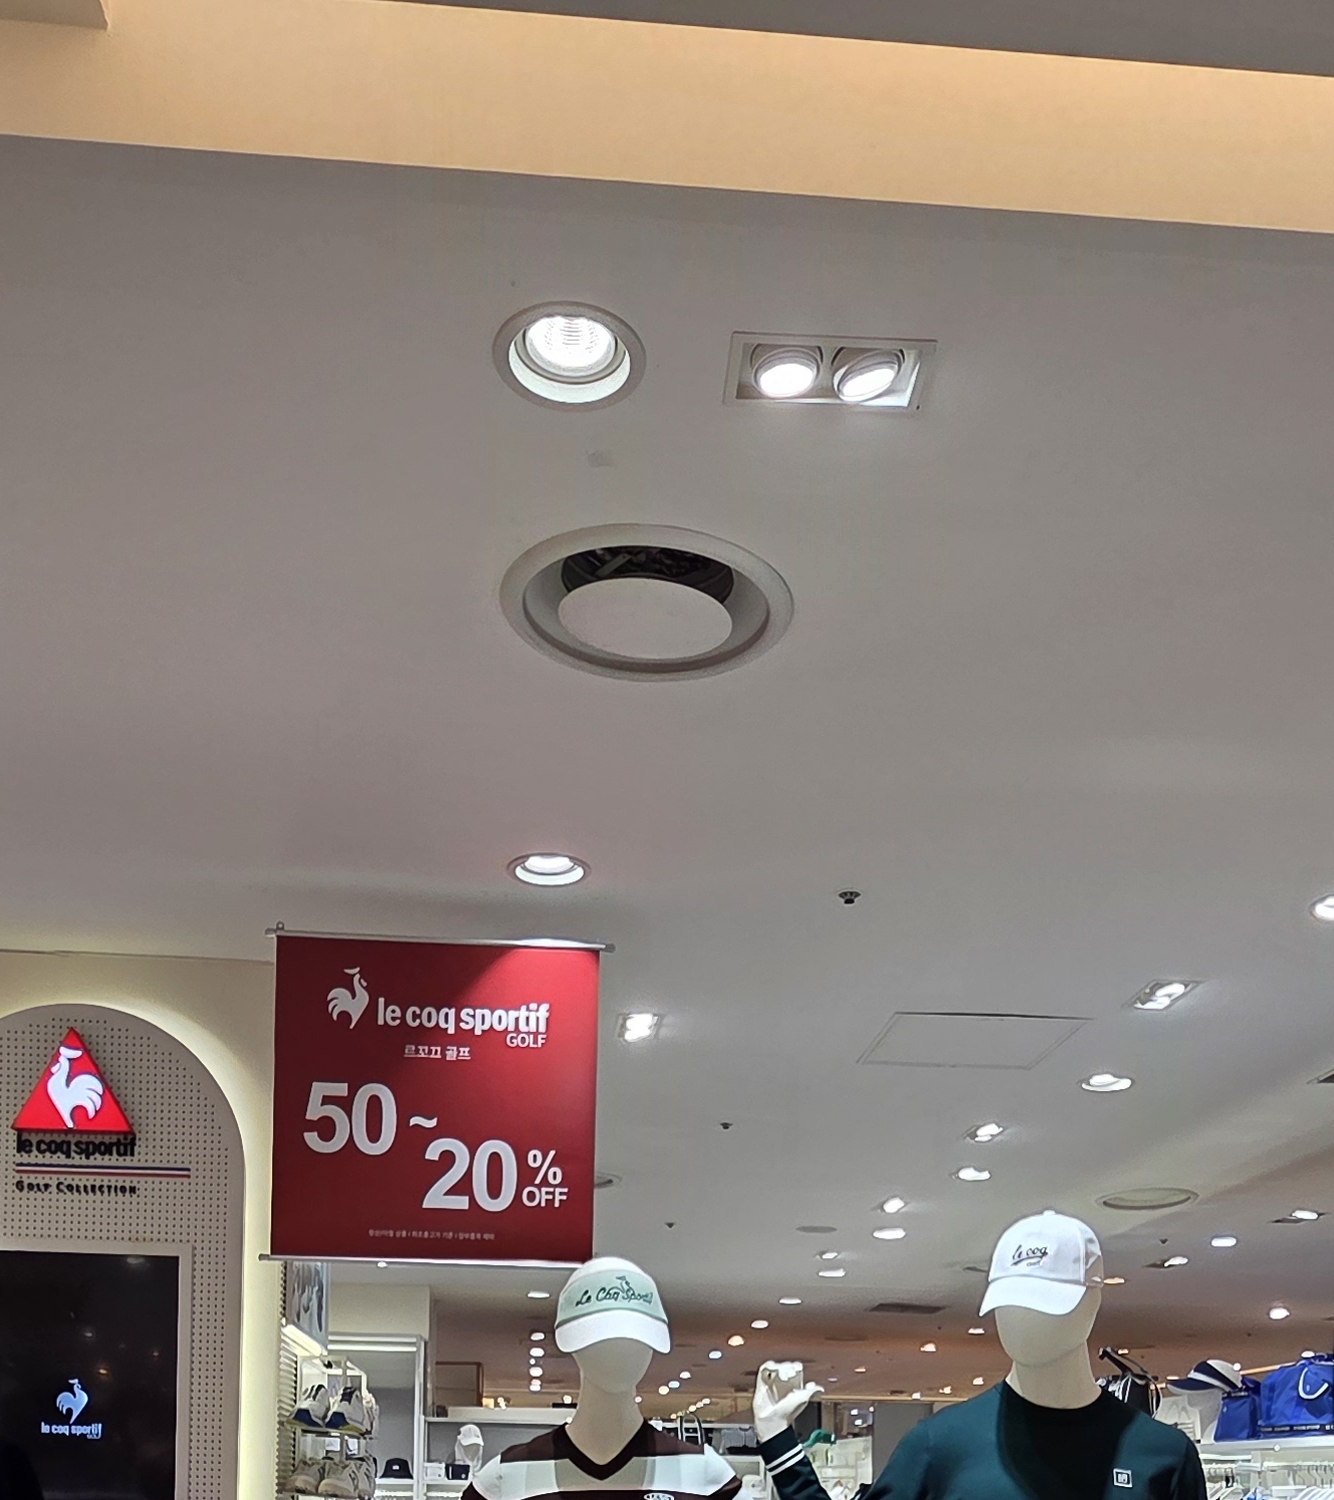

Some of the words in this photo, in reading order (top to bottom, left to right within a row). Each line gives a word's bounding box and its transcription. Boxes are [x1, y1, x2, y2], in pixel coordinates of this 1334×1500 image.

[377, 997, 402, 1027] le
[405, 1005, 456, 1034] coq
[459, 1002, 550, 1036] sportif
[506, 1023, 548, 1048] GOLF
[35, 1138, 72, 1159] coq
[73, 1134, 137, 1160] sportif
[522, 1186, 569, 1208] OFF
